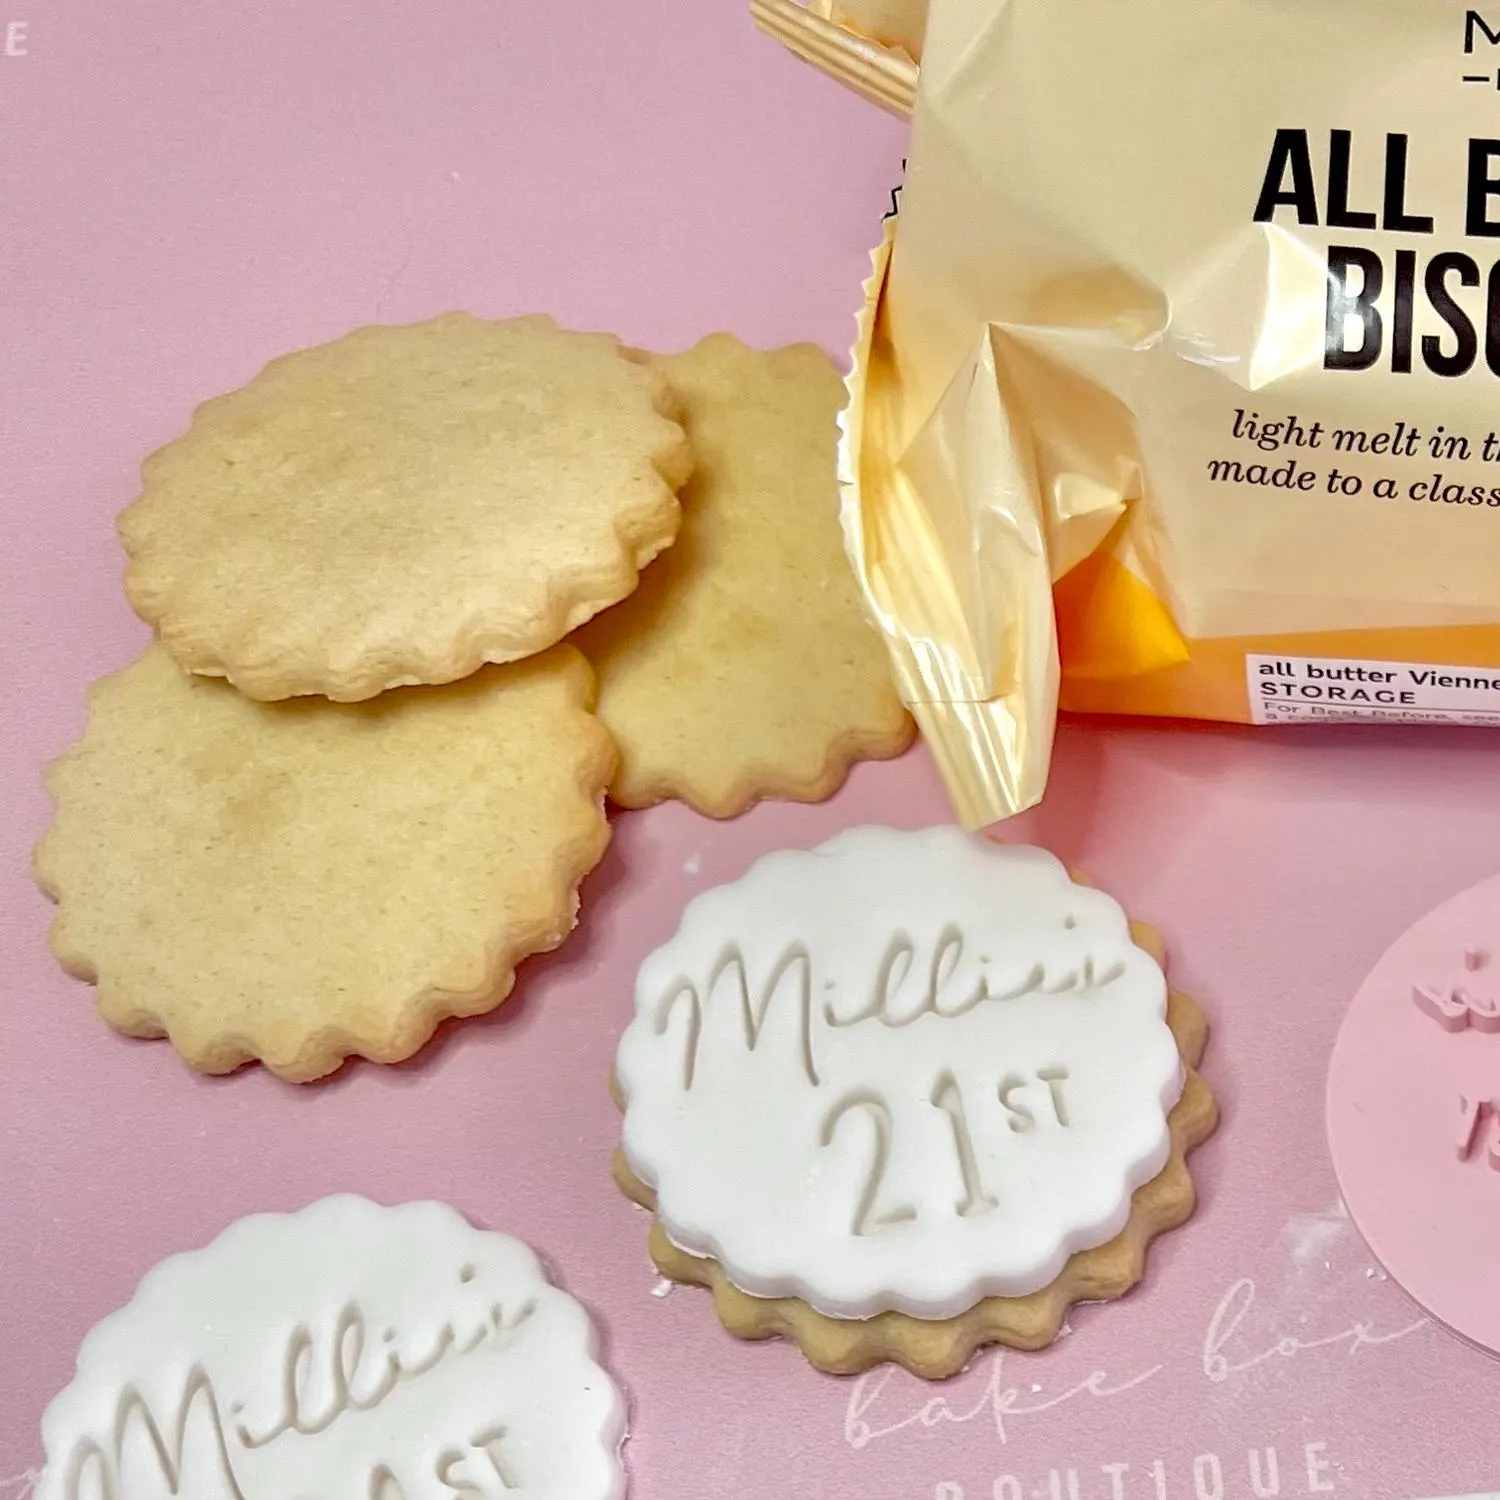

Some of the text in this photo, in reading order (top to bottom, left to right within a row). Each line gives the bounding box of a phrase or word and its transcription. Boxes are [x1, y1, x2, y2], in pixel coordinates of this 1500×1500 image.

[1253, 128, 1434, 234] ALL
[1231, 409, 1324, 450] light
[1332, 420, 1420, 459] melt
[1428, 426, 1470, 461] in
[1207, 455, 1316, 494] made
[1327, 466, 1363, 496] to
[1372, 476, 1399, 500] a
[1259, 661, 1295, 677] all
[1307, 664, 1398, 684] butter
[1261, 682, 1416, 705] STORAGE
